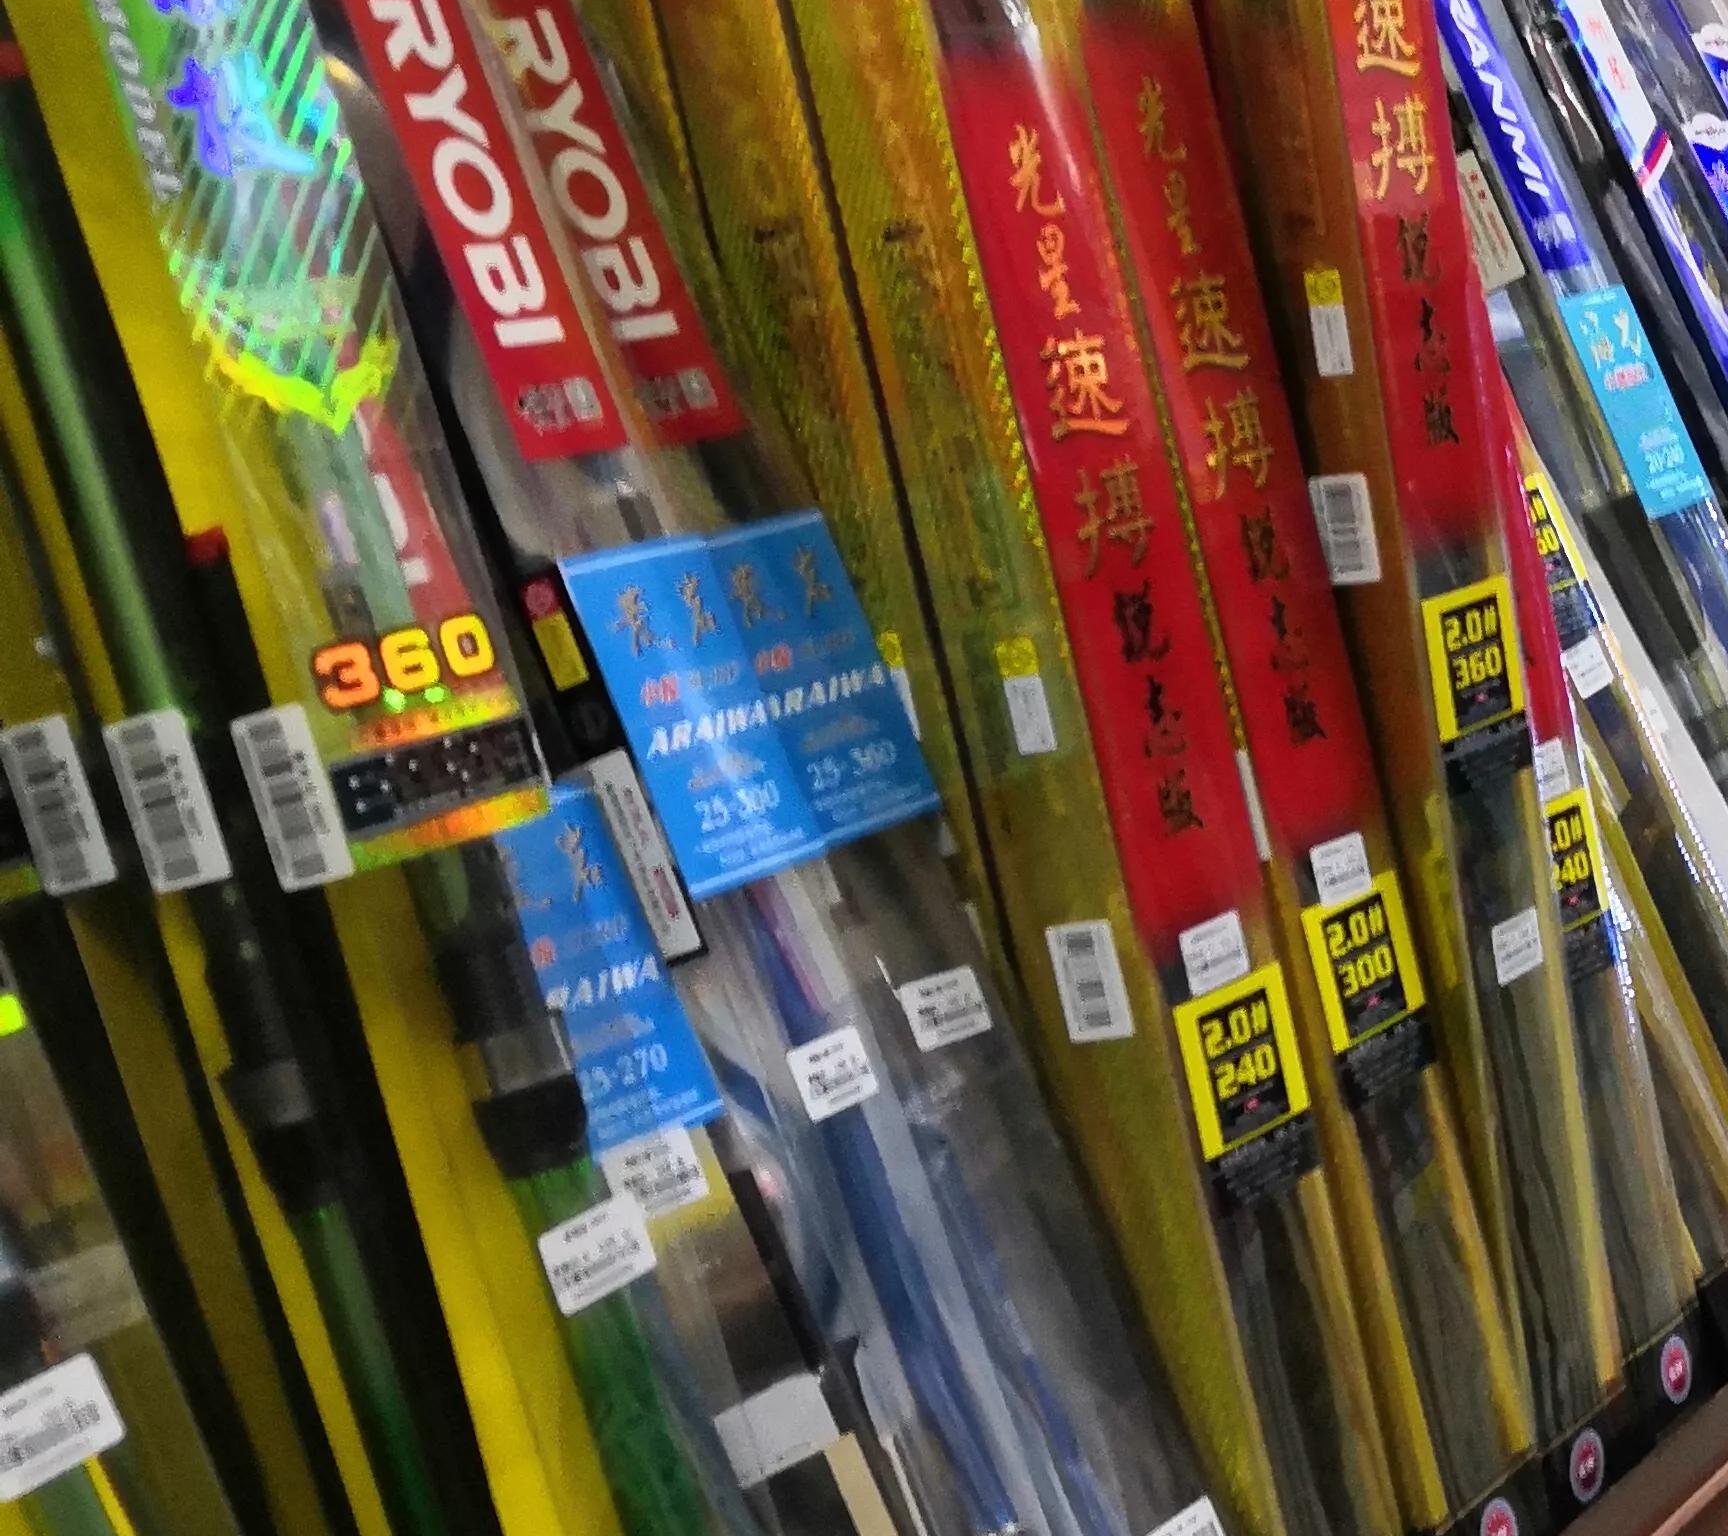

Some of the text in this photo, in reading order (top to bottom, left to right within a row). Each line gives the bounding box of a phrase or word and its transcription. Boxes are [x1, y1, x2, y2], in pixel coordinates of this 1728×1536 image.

[500, 7, 681, 342] RYOBI
[312, 613, 496, 710] 360
[1451, 643, 1503, 691] 360
[1337, 944, 1395, 999] 300
[1214, 1042, 1278, 1101] 240
